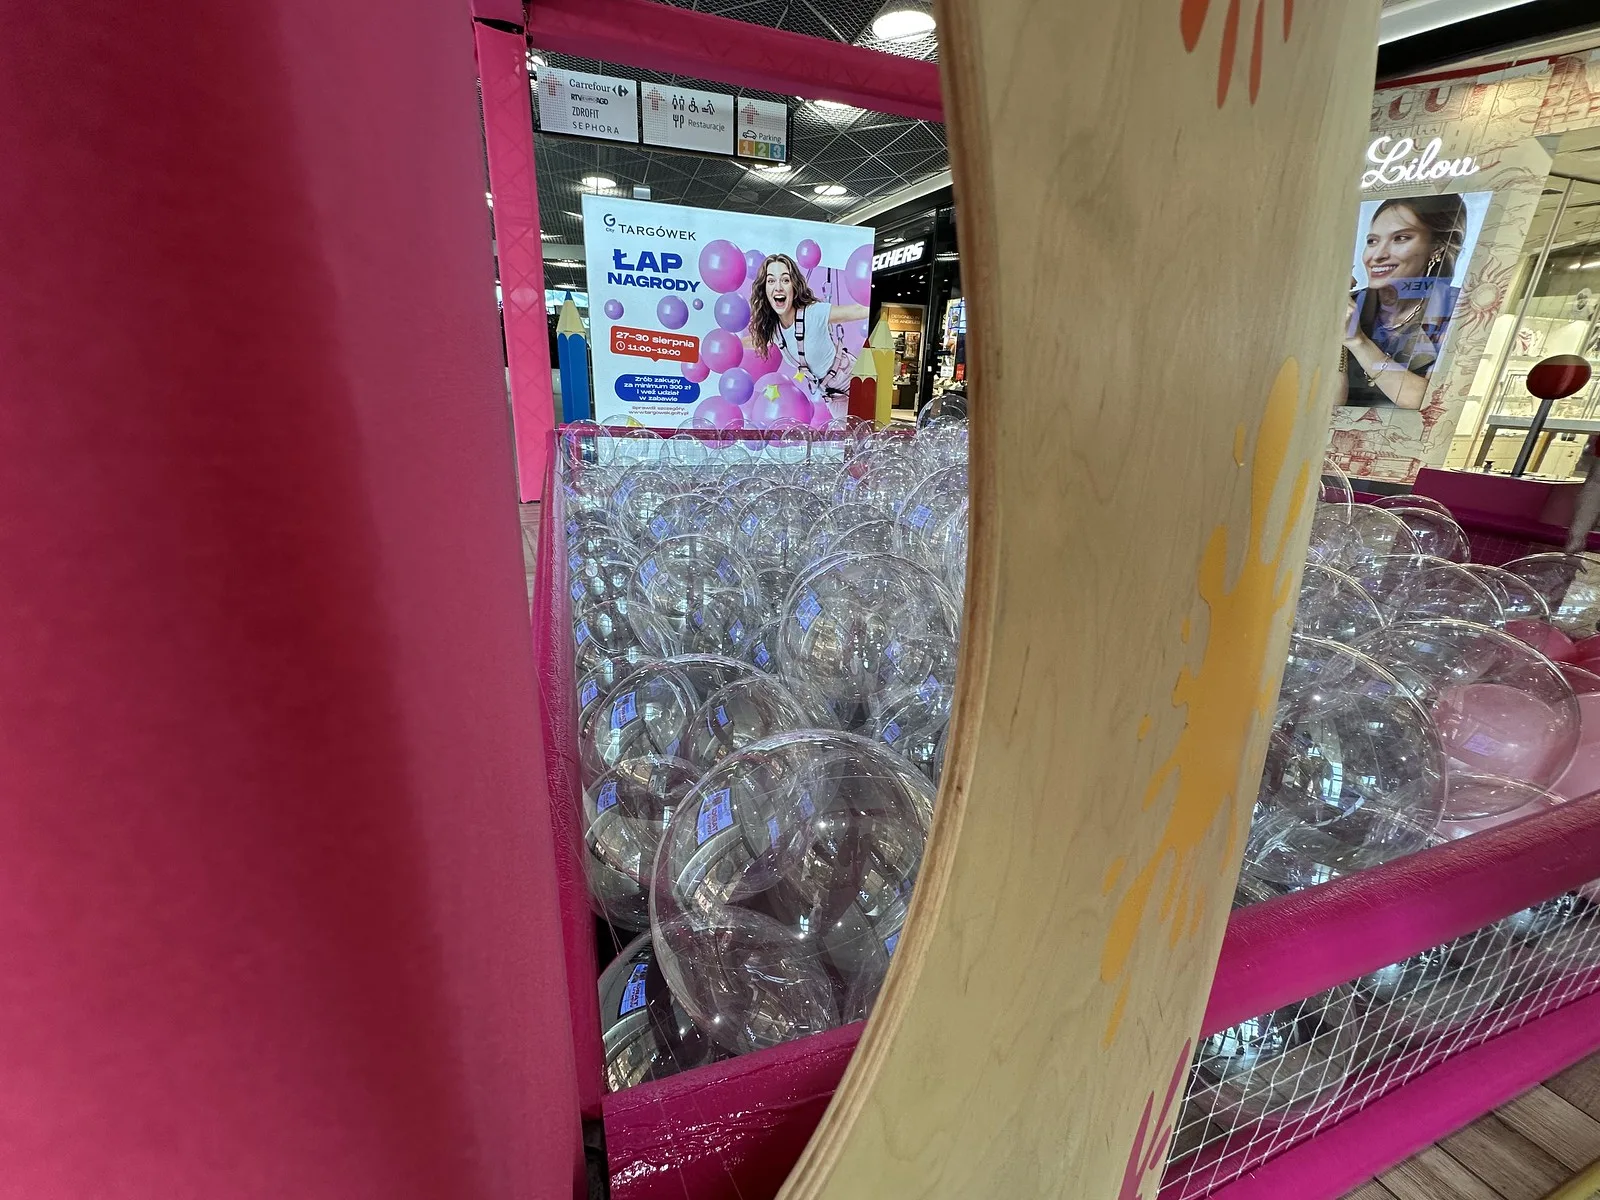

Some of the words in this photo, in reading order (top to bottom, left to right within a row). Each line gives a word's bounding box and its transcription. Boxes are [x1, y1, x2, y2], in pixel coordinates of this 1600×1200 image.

[569, 79, 611, 93] Carrefour
[572, 106, 600, 119] ZDROFIT
[572, 121, 620, 135] SEPHORA
[688, 119, 726, 132] Restauracje
[758, 132, 782, 144] Parking
[742, 141, 751, 155] 1
[757, 143, 767, 157] 2
[773, 144, 782, 159] 3
[1361, 135, 1481, 188] Lilou
[618, 223, 697, 241] TARGÓWEK
[612, 248, 683, 273] ŁAP
[872, 241, 925, 272] ECHERS
[607, 271, 701, 293] NAGRODY
[652, 336, 695, 348] sierpnia
[654, 377, 681, 385] zakupy
